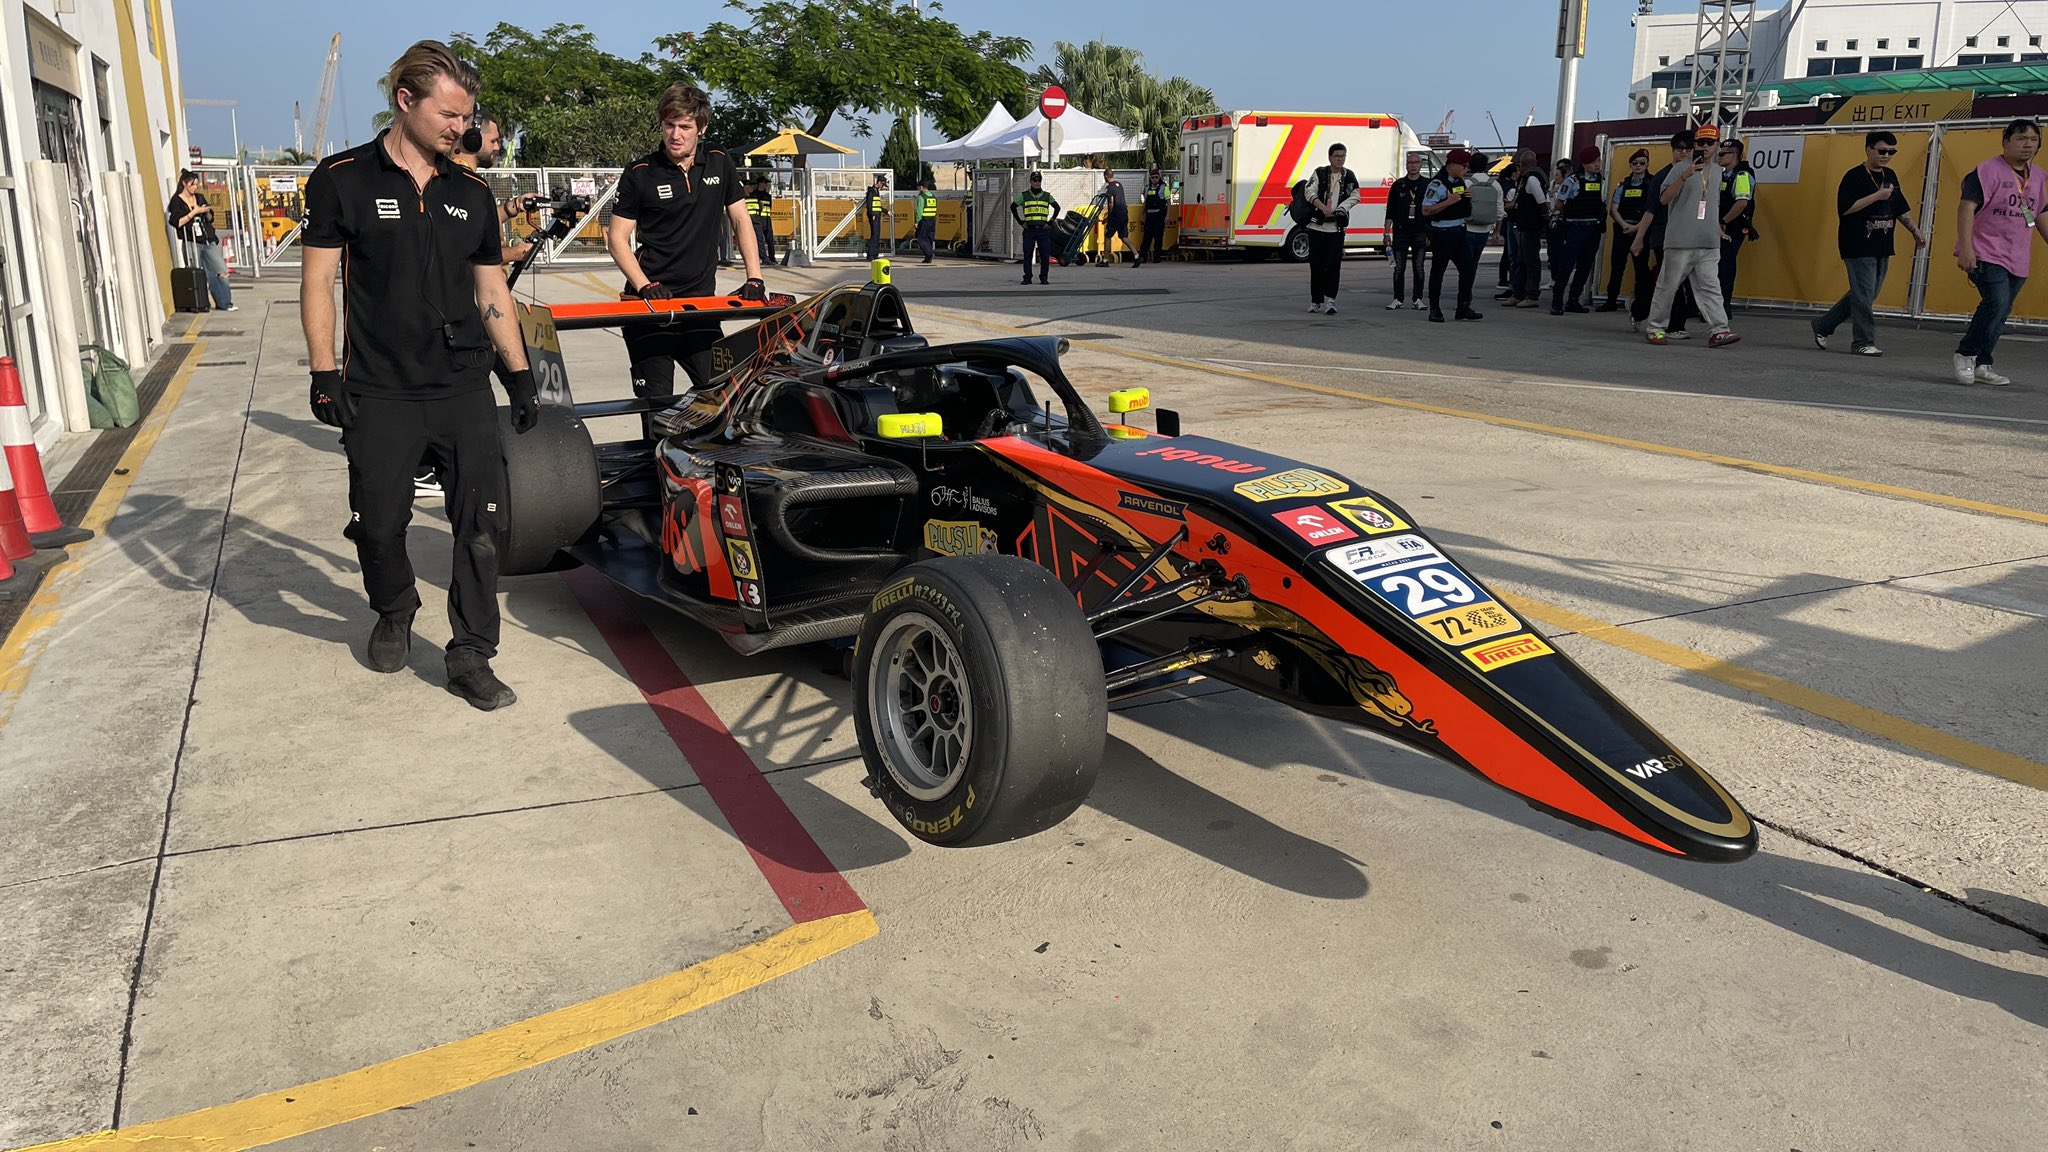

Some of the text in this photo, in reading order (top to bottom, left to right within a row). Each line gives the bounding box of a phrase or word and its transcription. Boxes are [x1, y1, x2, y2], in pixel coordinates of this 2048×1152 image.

[1852, 105, 1885, 122] 出口
[1894, 104, 1931, 120] EXIT
[1753, 150, 1795, 169] OUT
[703, 176, 720, 185] VAR
[1380, 178, 1395, 187] A2
[443, 204, 469, 221] VAR
[539, 359, 564, 404] 29
[900, 420, 926, 434] PLUSH
[1135, 446, 1267, 473] mubi
[727, 475, 742, 486] VAR
[1239, 468, 1341, 500] PLUSH
[972, 496, 990, 506] BALIUS
[972, 503, 998, 515] ADVISORS
[1124, 496, 1180, 516] RAVENOL
[725, 521, 742, 530] ORLEN
[1308, 526, 1346, 539] ORLEN
[662, 502, 701, 572] ubi
[928, 523, 978, 556] PLUSH
[1398, 540, 1422, 550] FIA
[1345, 546, 1374, 561] FR
[1348, 555, 1373, 565] WORLD
[872, 576, 915, 614] PIRELLI
[1381, 568, 1476, 616] 29
[1430, 616, 1473, 640] 72
[1473, 638, 1543, 665] PIRELLI
[966, 783, 976, 809] P
[912, 805, 964, 834] ZERO
